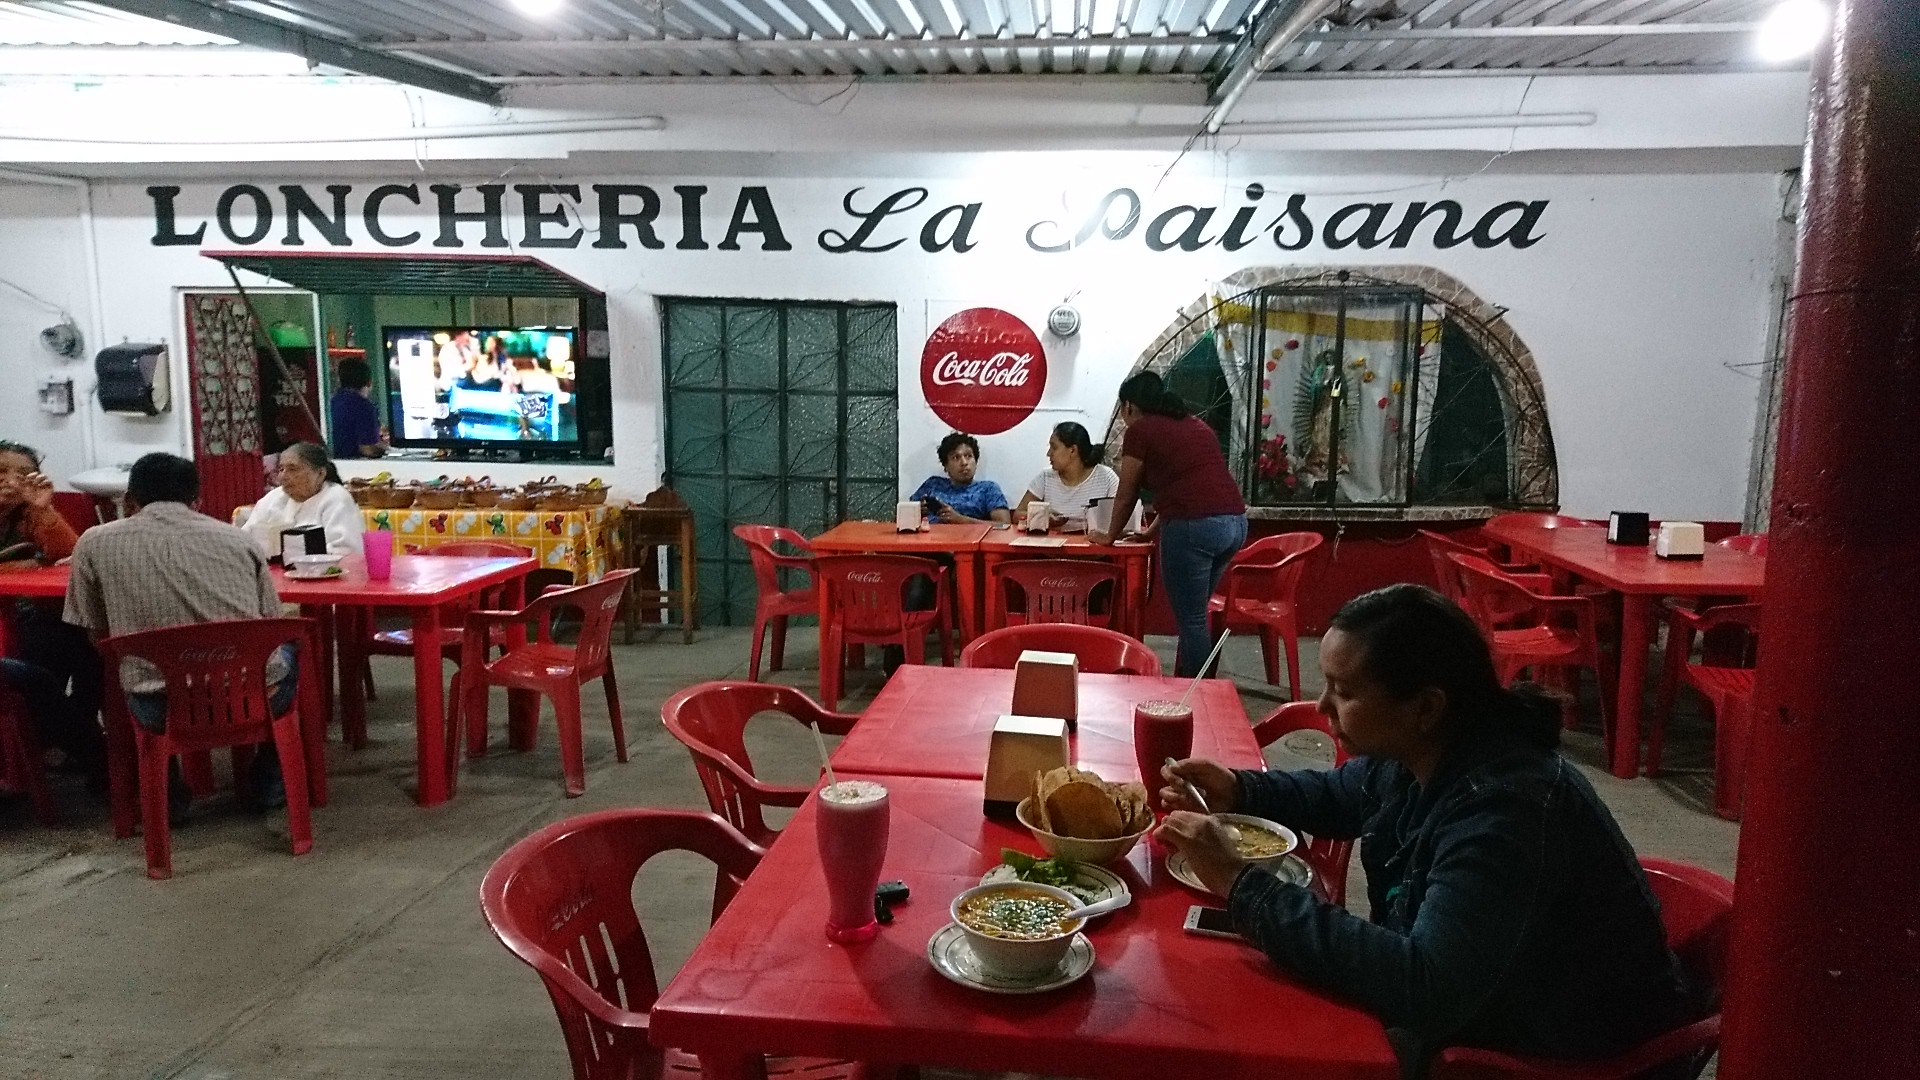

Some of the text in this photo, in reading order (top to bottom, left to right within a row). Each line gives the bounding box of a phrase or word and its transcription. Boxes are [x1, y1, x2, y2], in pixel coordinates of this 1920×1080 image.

[146, 183, 1549, 254] LONCHERIA La Paisana
